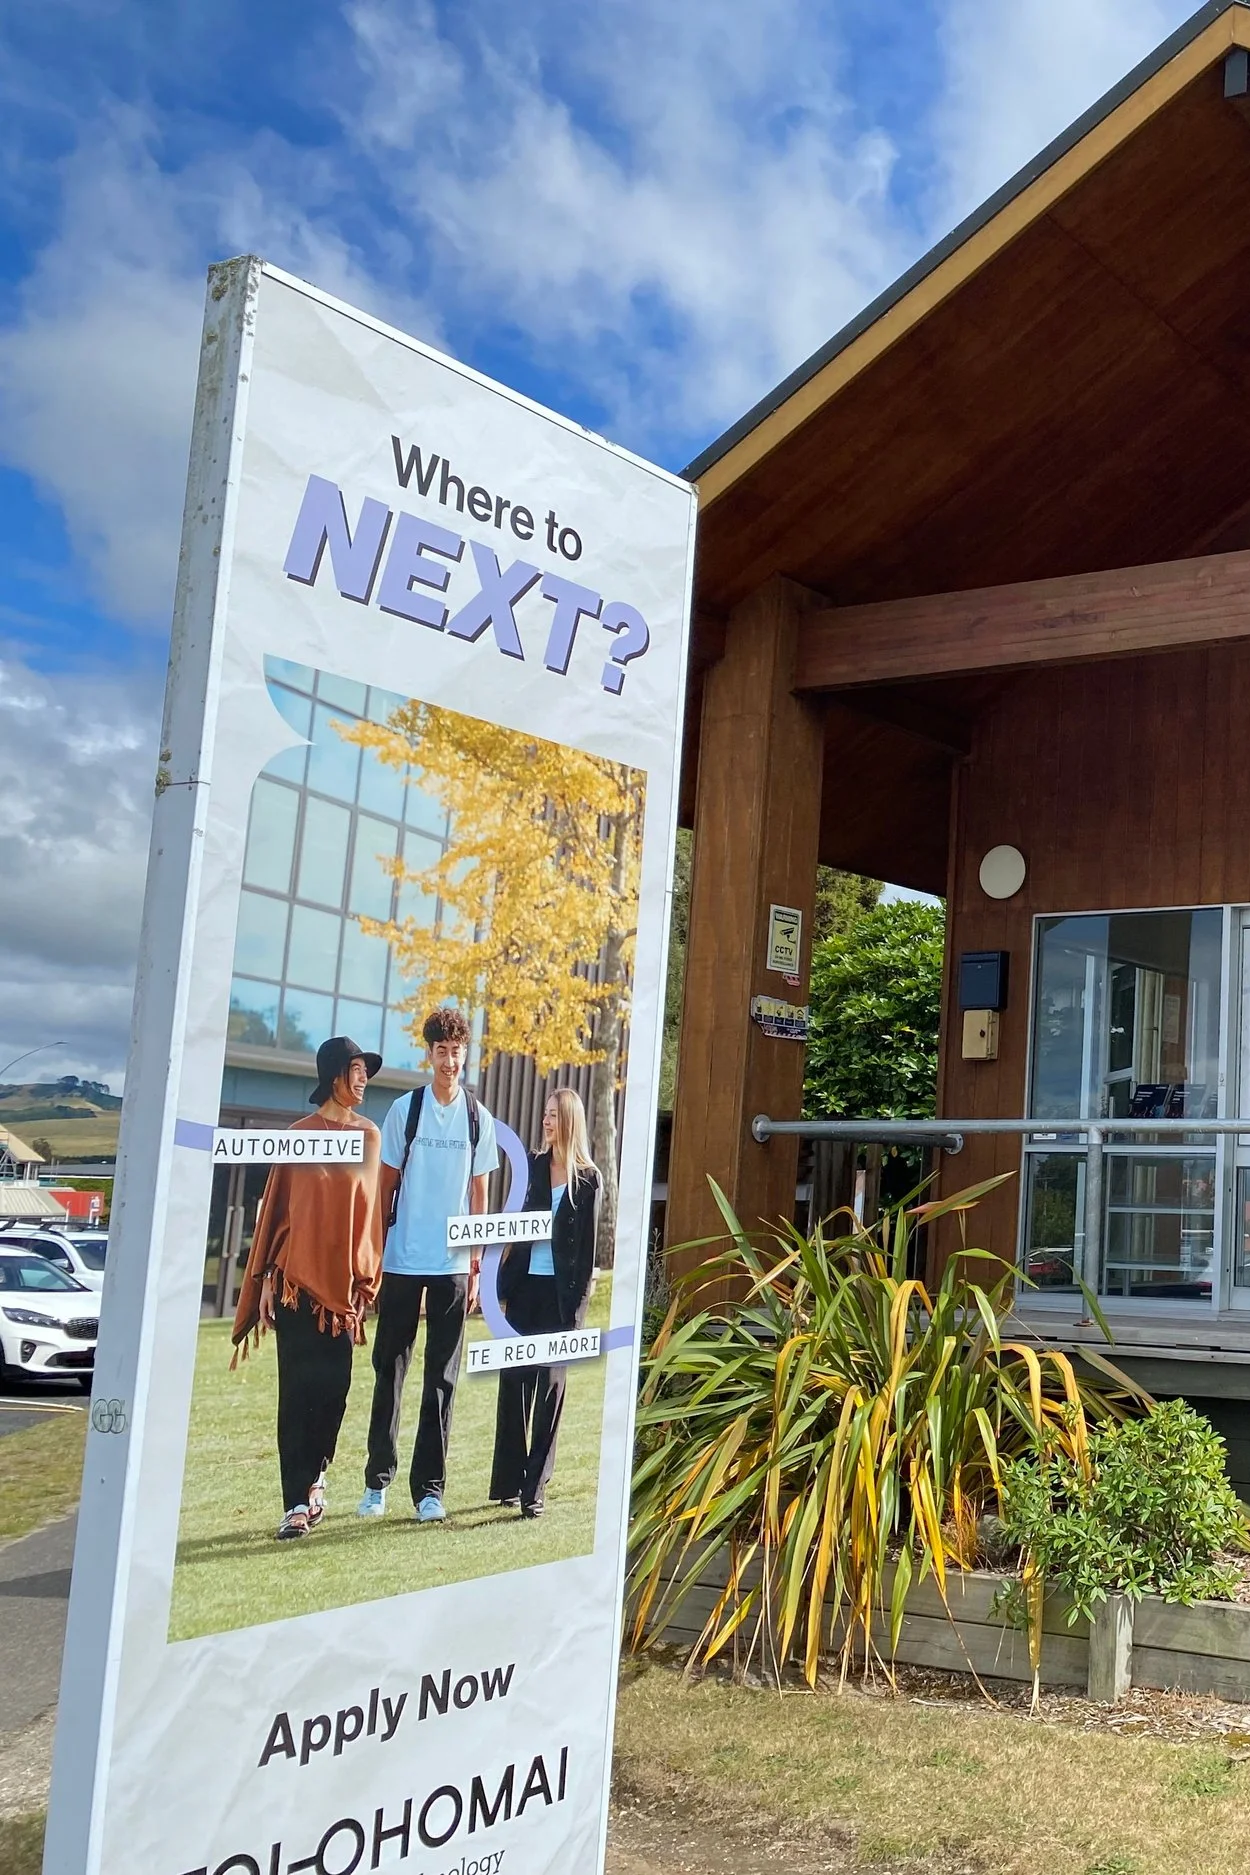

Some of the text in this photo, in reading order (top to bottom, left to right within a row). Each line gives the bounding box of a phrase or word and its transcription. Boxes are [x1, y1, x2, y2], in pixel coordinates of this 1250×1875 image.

[391, 435, 582, 561] Where to
[283, 474, 650, 696] NEXT?
[775, 945, 793, 956] CCTV
[214, 1138, 361, 1156] AUTOMOTIVE
[449, 1218, 551, 1240] CARPENTRY
[470, 1335, 598, 1366] TE REO MĀORI
[257, 1663, 515, 1768] Apply Now
